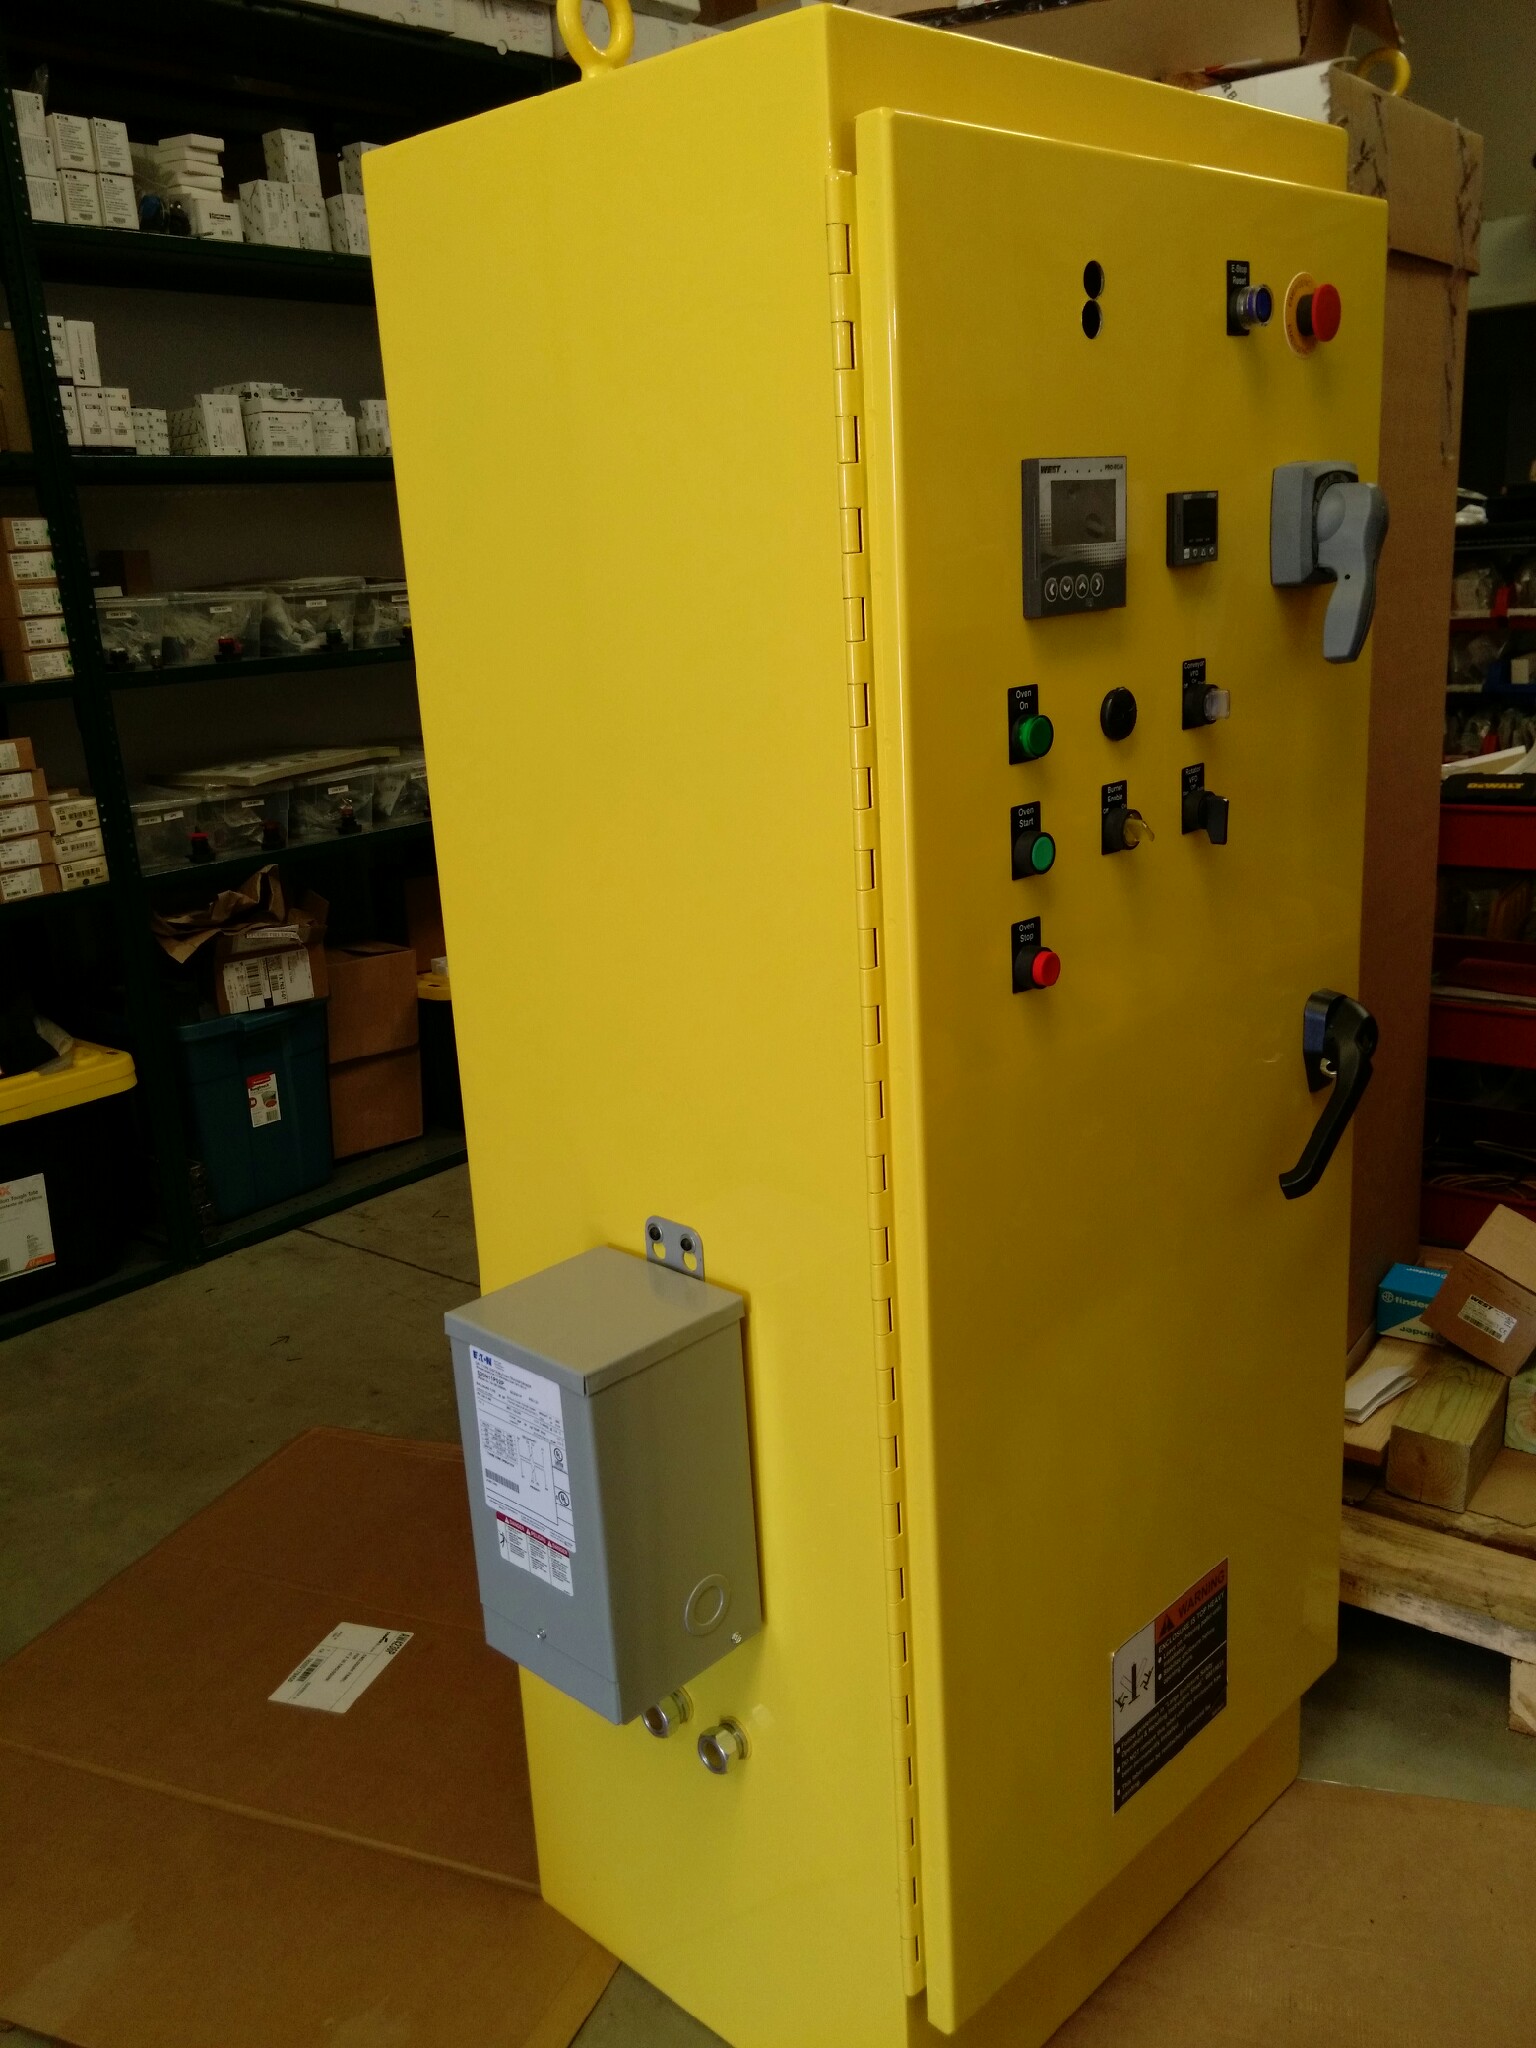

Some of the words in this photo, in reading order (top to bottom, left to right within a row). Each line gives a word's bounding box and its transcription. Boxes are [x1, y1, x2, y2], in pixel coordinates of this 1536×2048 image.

[1231, 264, 1248, 274] E-Stop
[1040, 466, 1060, 474] WEST
[1016, 690, 1032, 698] Oven
[1020, 701, 1028, 710] On
[1108, 785, 1122, 794] Burner
[1018, 806, 1034, 817] Oven
[1019, 818, 1034, 828] Start
[1019, 922, 1035, 932] Oven
[1020, 932, 1034, 943] Stop
[1470, 1295, 1494, 1310] WEST
[1178, 1568, 1224, 1619] WARNING
[1158, 1620, 1188, 1654] ENCLOSURE
[1197, 1604, 1206, 1619] TOP
[1207, 1589, 1224, 1610] HEAVY
